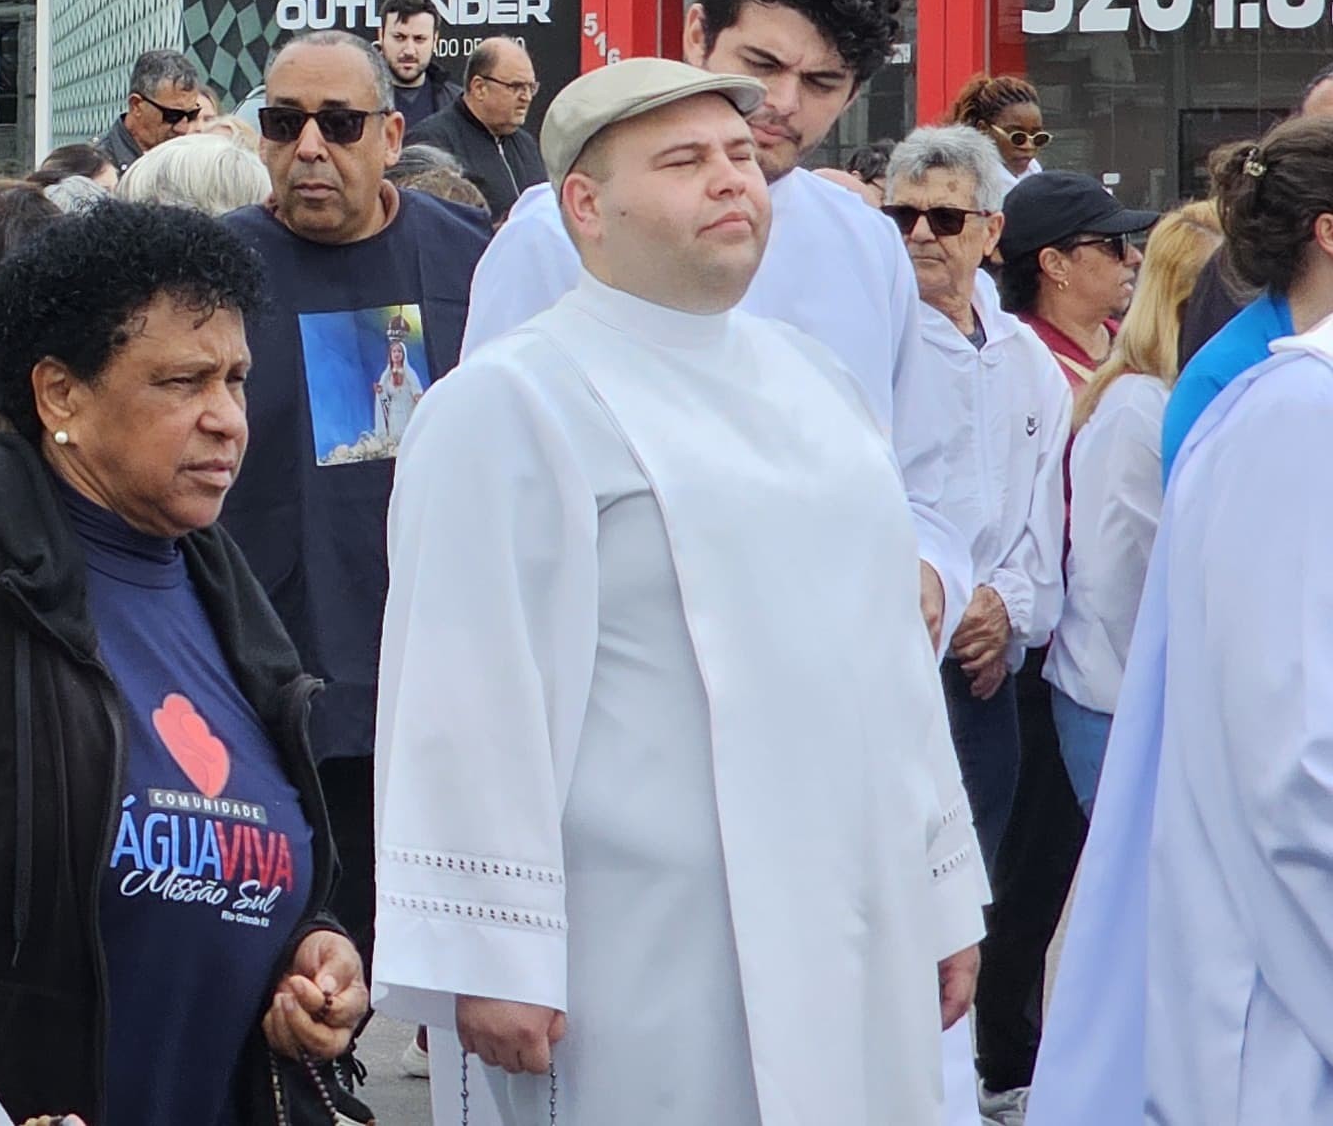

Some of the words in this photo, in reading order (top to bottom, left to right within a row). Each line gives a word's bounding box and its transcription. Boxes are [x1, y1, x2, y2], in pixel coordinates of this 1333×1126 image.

[154, 792, 261, 820] COMUNIDADE
[120, 870, 228, 906] Missão
[232, 880, 282, 913] Sul
